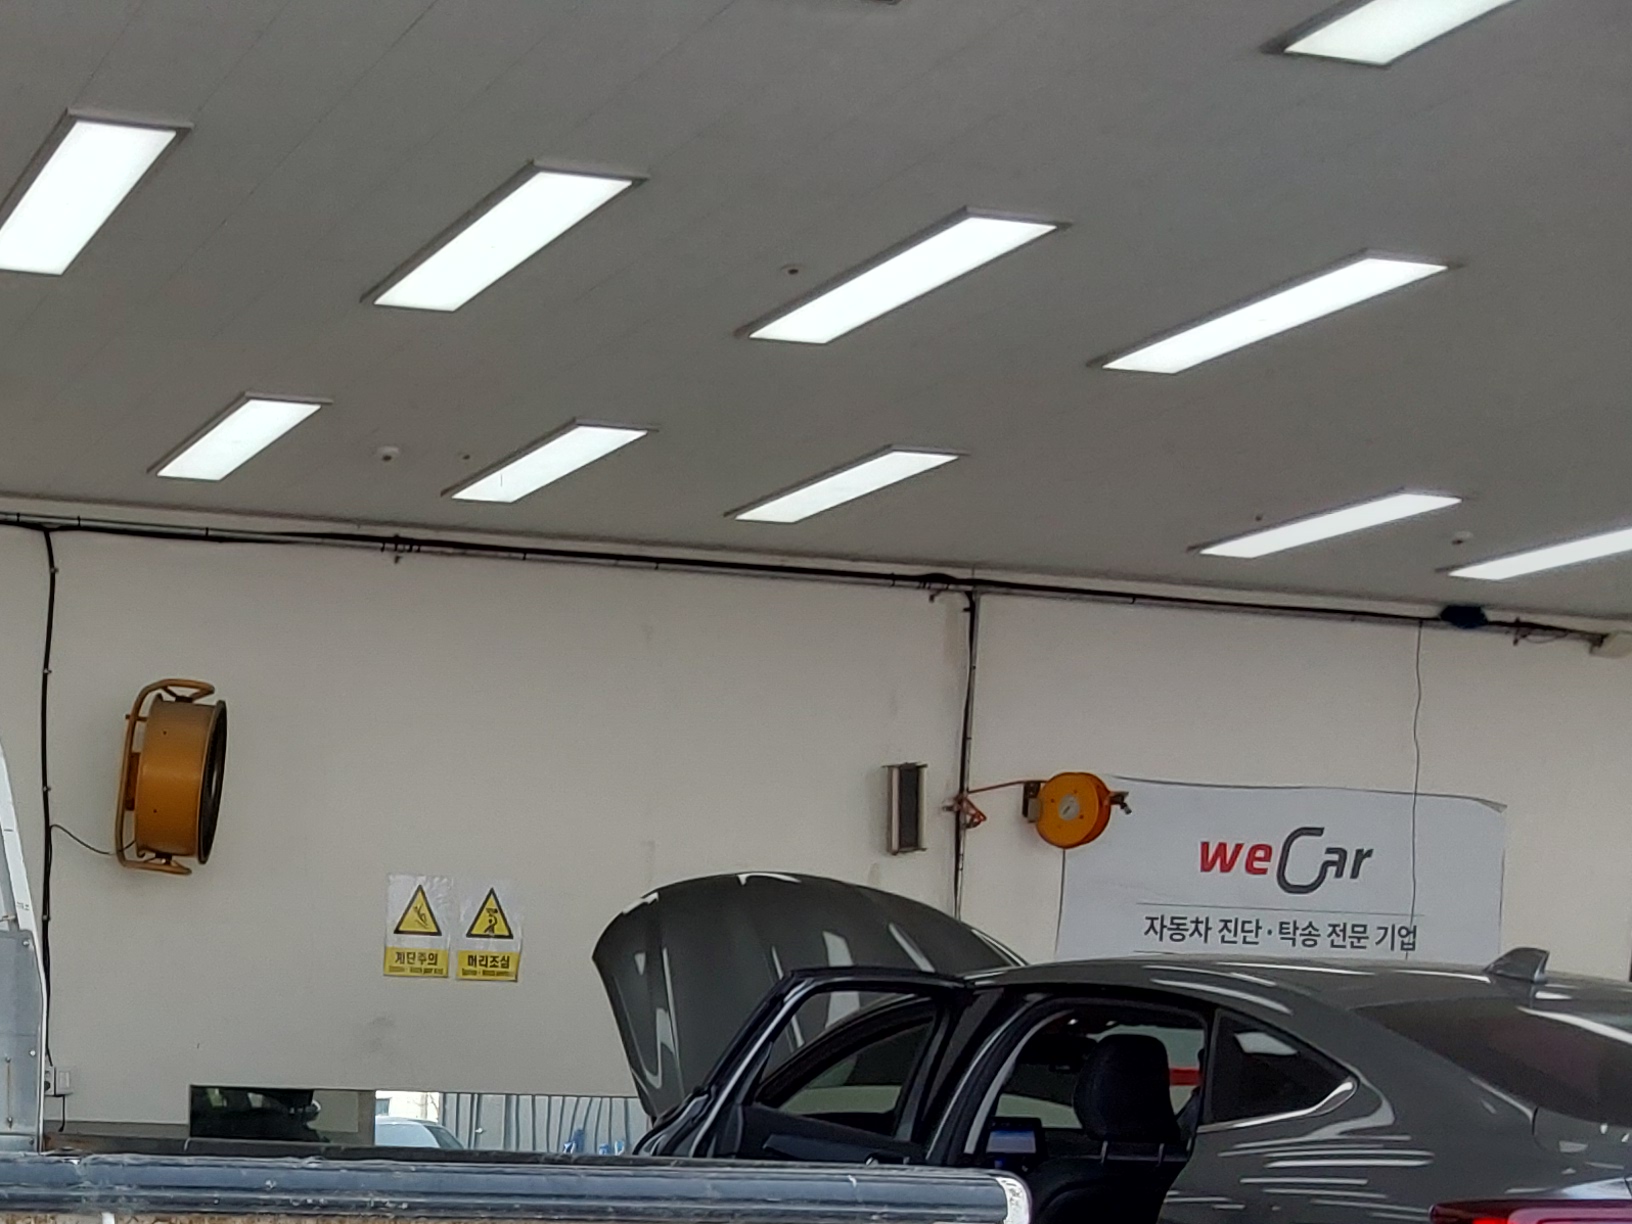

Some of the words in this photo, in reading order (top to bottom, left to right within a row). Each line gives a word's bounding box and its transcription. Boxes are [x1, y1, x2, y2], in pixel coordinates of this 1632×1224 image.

[1199, 826, 1375, 895] weCar
[1143, 914, 1213, 944] 자동차
[1326, 923, 1371, 950] 전문
[1374, 923, 1419, 953] 기업
[394, 951, 439, 966] 계단주의
[466, 954, 511, 969] 머리조심
